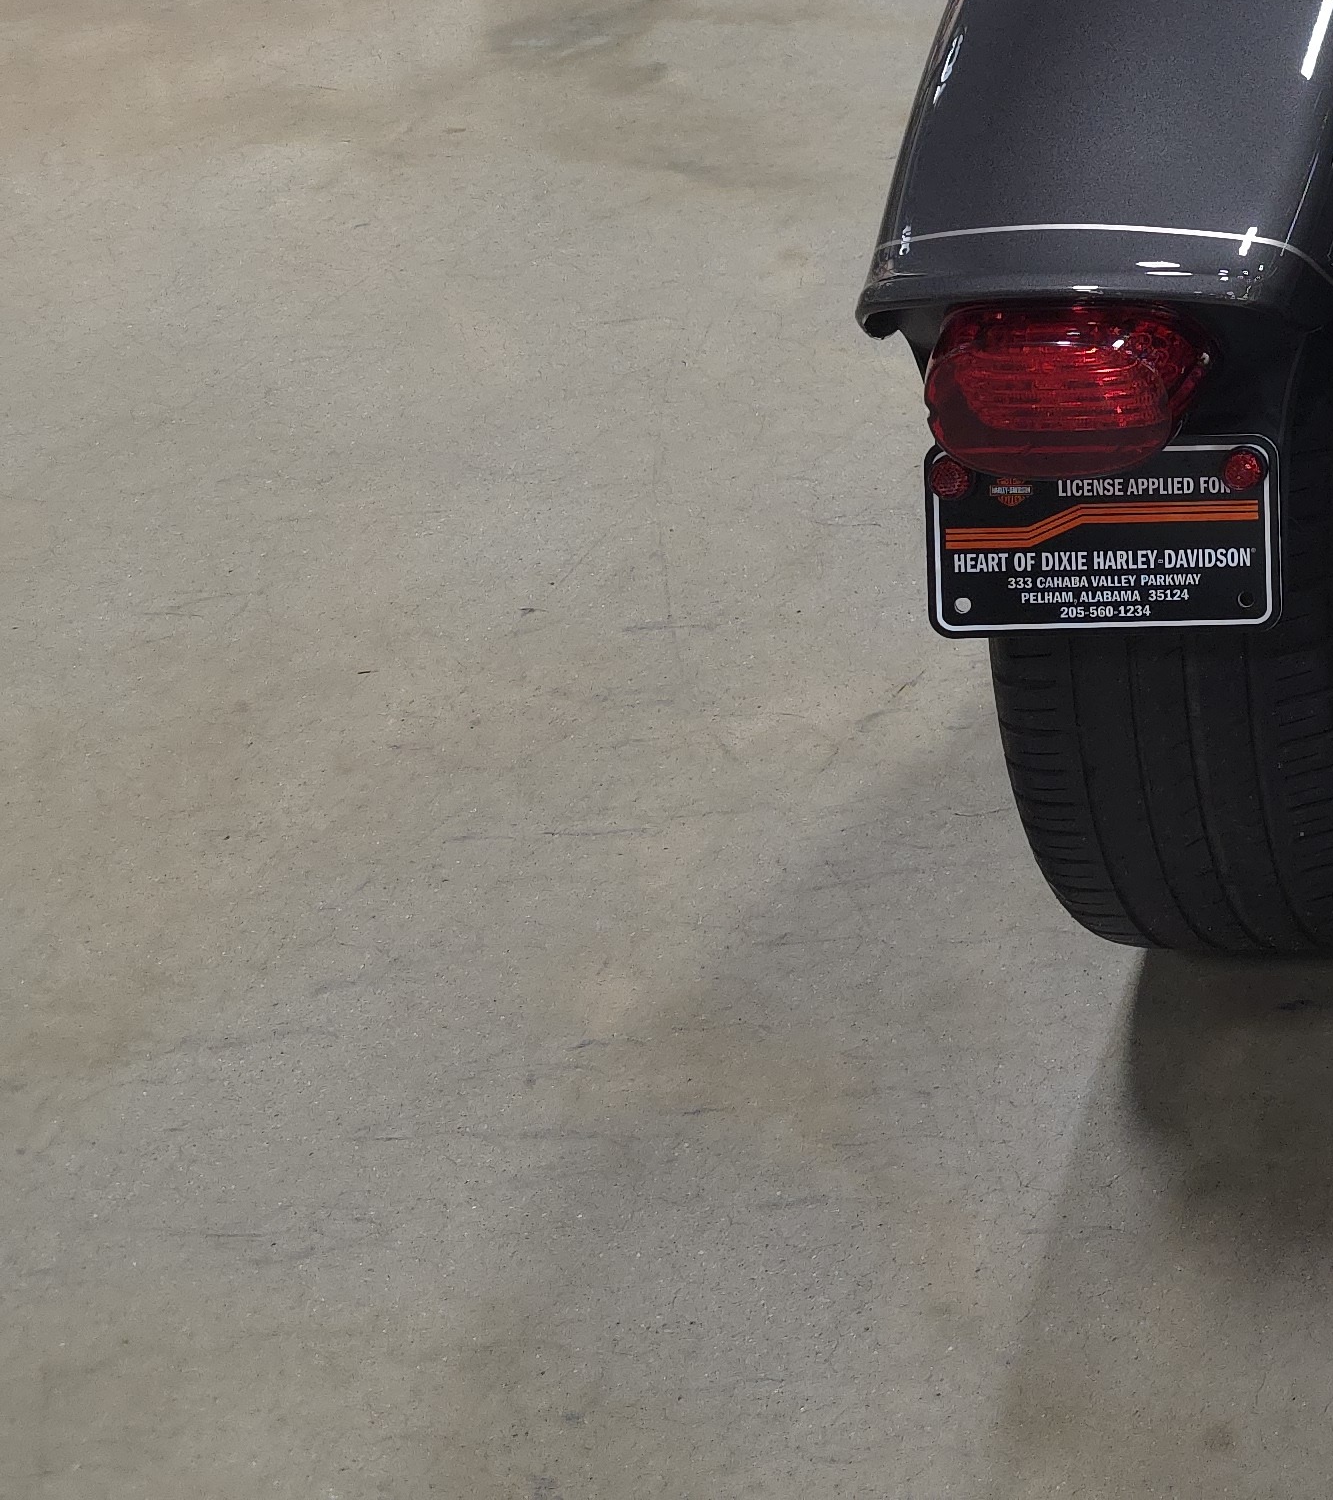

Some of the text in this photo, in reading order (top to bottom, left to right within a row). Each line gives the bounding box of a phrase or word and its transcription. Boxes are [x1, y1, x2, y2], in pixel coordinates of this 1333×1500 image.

[1057, 478, 1124, 497] LICENSE
[1126, 477, 1195, 495] APPLIED
[953, 552, 1009, 573] HEART
[1013, 552, 1036, 572] OF
[1041, 551, 1088, 571] DIXIE
[1007, 573, 1202, 589] 333 CAHABA VALLEY PARKWAY
[1021, 588, 1190, 605] PELHAM, ALABAMA 35124
[1060, 605, 1152, 618] 205-560-1234
